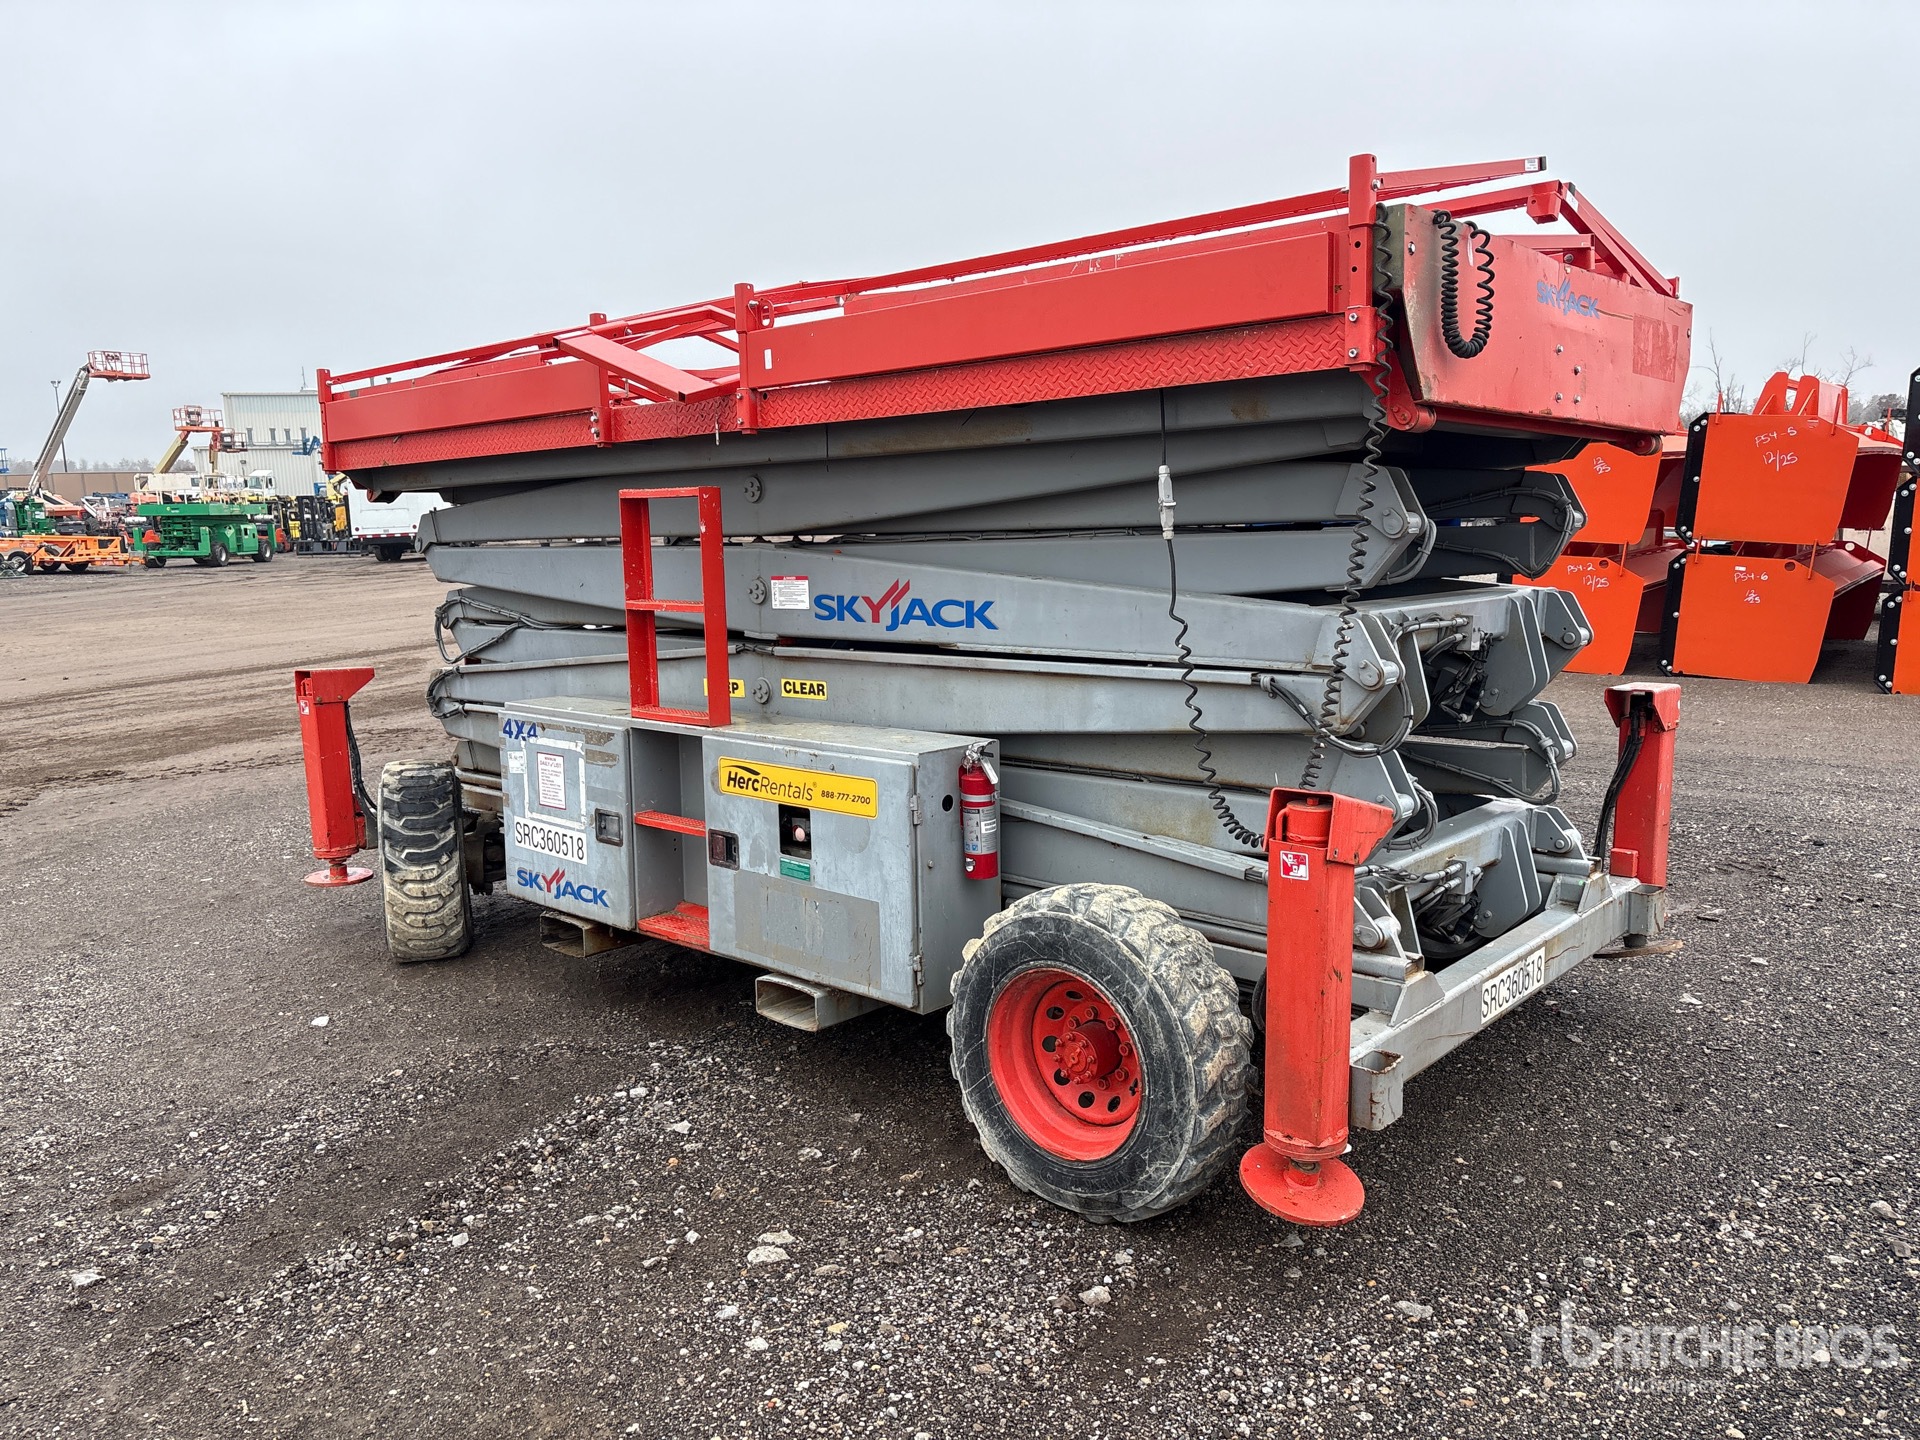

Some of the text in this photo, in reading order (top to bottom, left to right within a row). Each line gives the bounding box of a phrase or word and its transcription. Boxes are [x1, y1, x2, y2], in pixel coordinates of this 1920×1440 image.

[1536, 277, 1600, 319] SKYJACK
[813, 578, 999, 632] SKYJACK
[783, 681, 826, 697] CLEAR
[502, 718, 539, 741] 4X4
[820, 789, 871, 805] 888-777-2700
[515, 822, 584, 860] SRC360518
[516, 867, 610, 908] SKYJACK
[1481, 955, 1543, 1018] SRC360518
